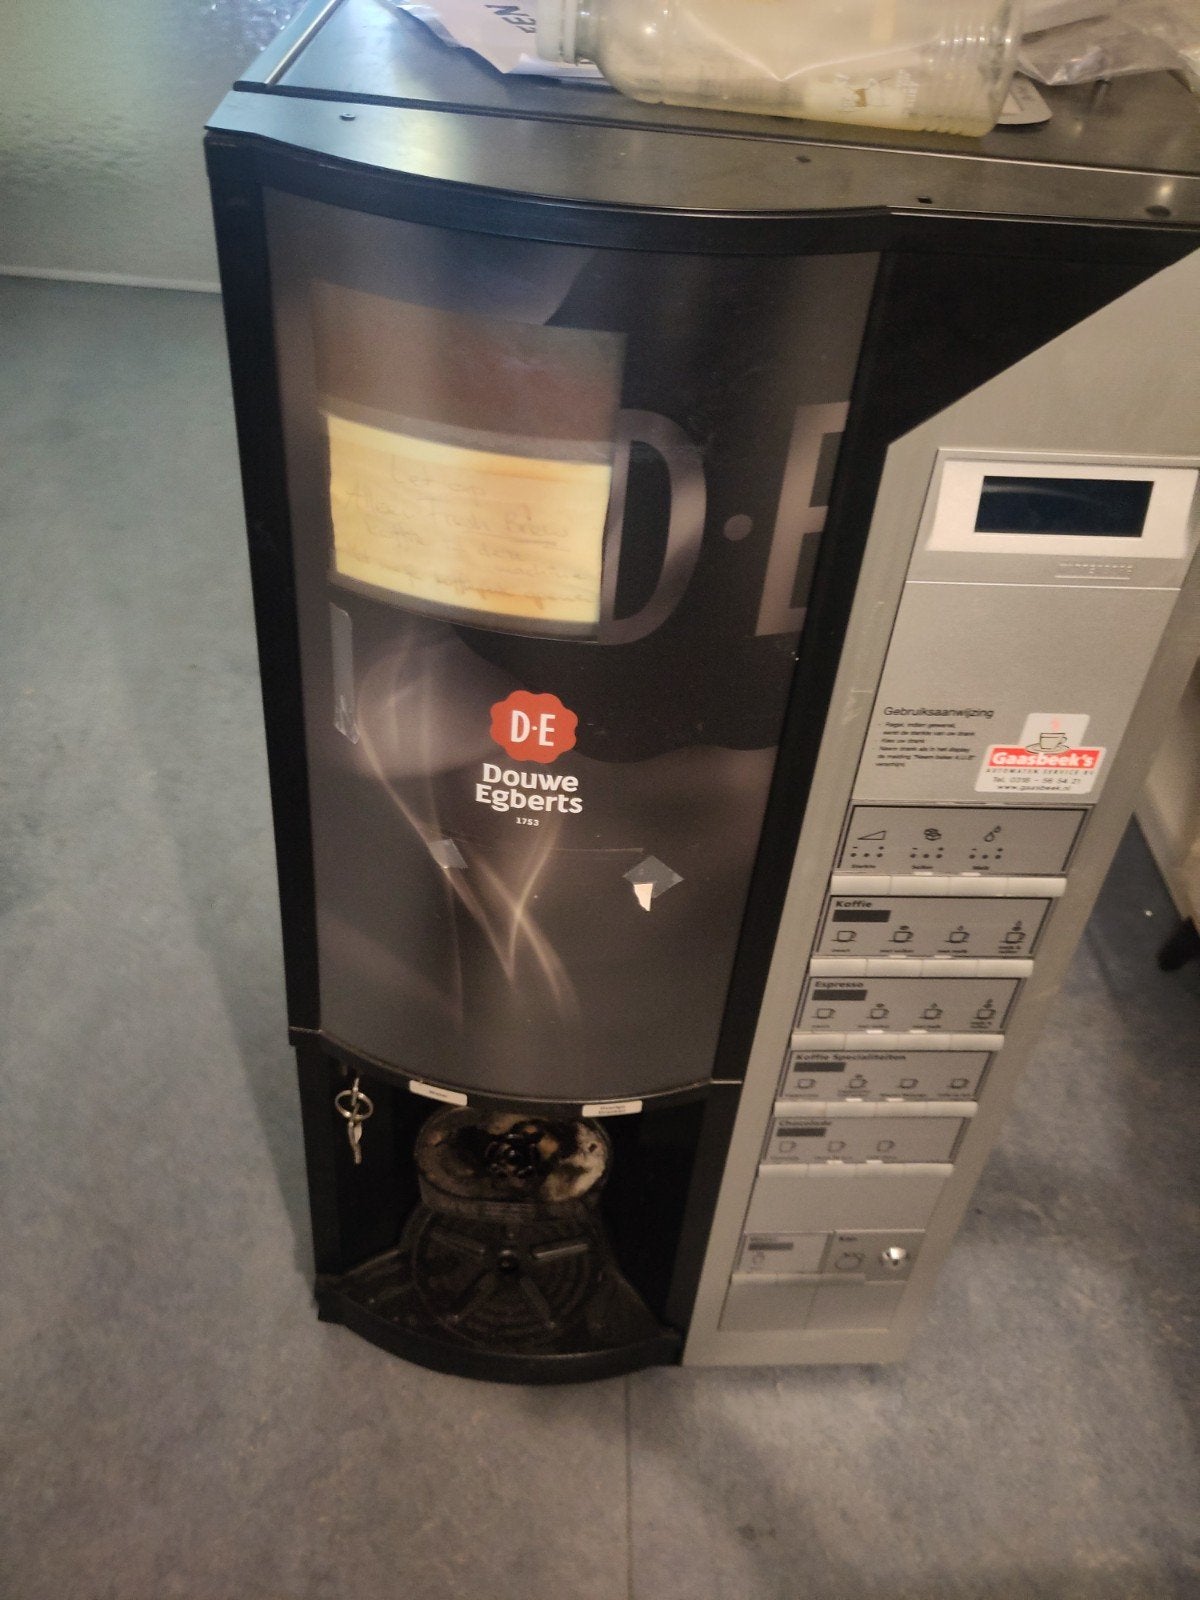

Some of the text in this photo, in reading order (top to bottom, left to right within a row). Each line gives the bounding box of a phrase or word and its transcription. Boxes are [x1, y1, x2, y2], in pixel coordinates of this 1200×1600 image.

[883, 706, 995, 719] Gebruiksaanwijzing
[992, 752, 1094, 767] Gaasbeek's
[482, 762, 579, 792] Douwe
[475, 783, 583, 814] Egberts
[515, 817, 541, 827] 1753
[836, 900, 873, 909] Koffie
[814, 980, 864, 989] Espresso
